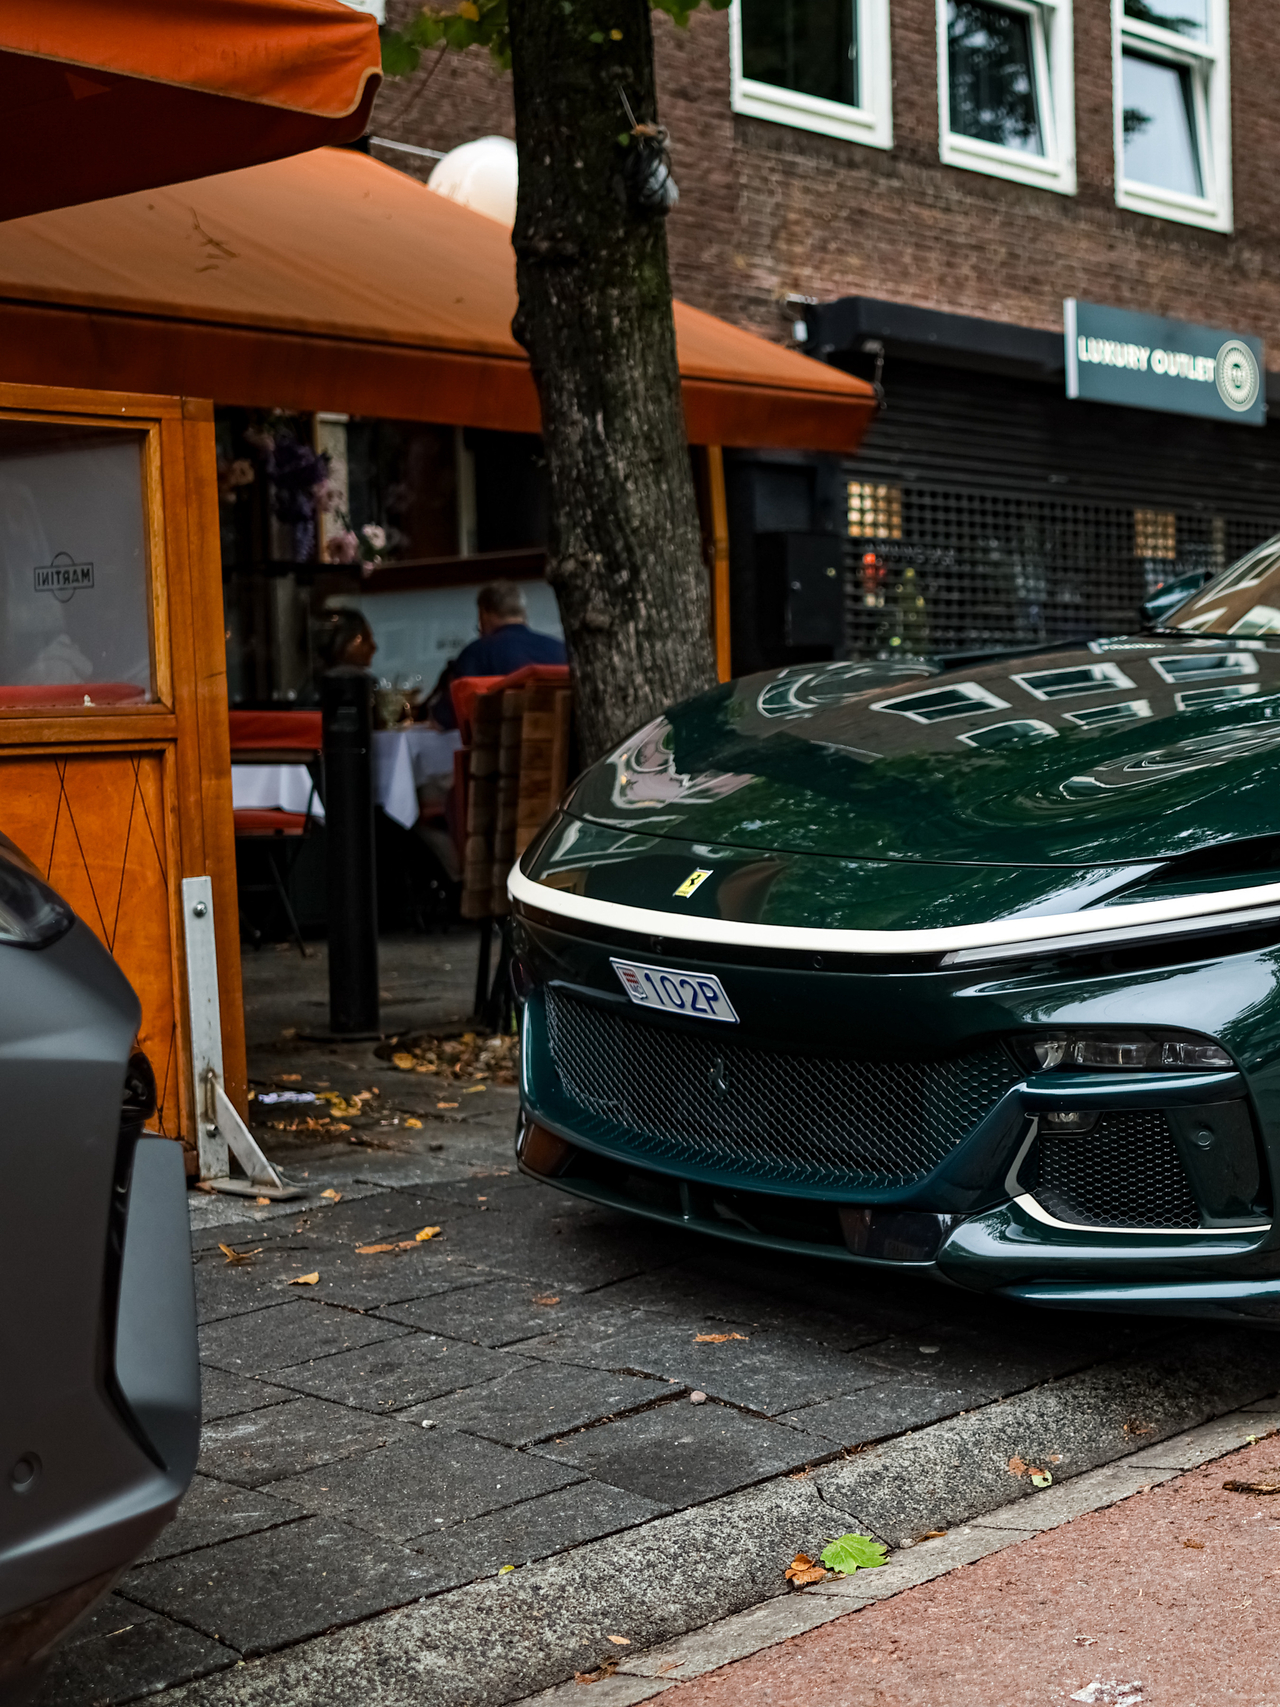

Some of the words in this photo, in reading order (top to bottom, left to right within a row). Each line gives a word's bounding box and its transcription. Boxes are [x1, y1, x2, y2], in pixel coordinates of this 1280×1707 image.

[1078, 335, 1150, 371] LUXURY
[1151, 348, 1216, 382] OUTLET
[644, 972, 719, 1015] 102P
